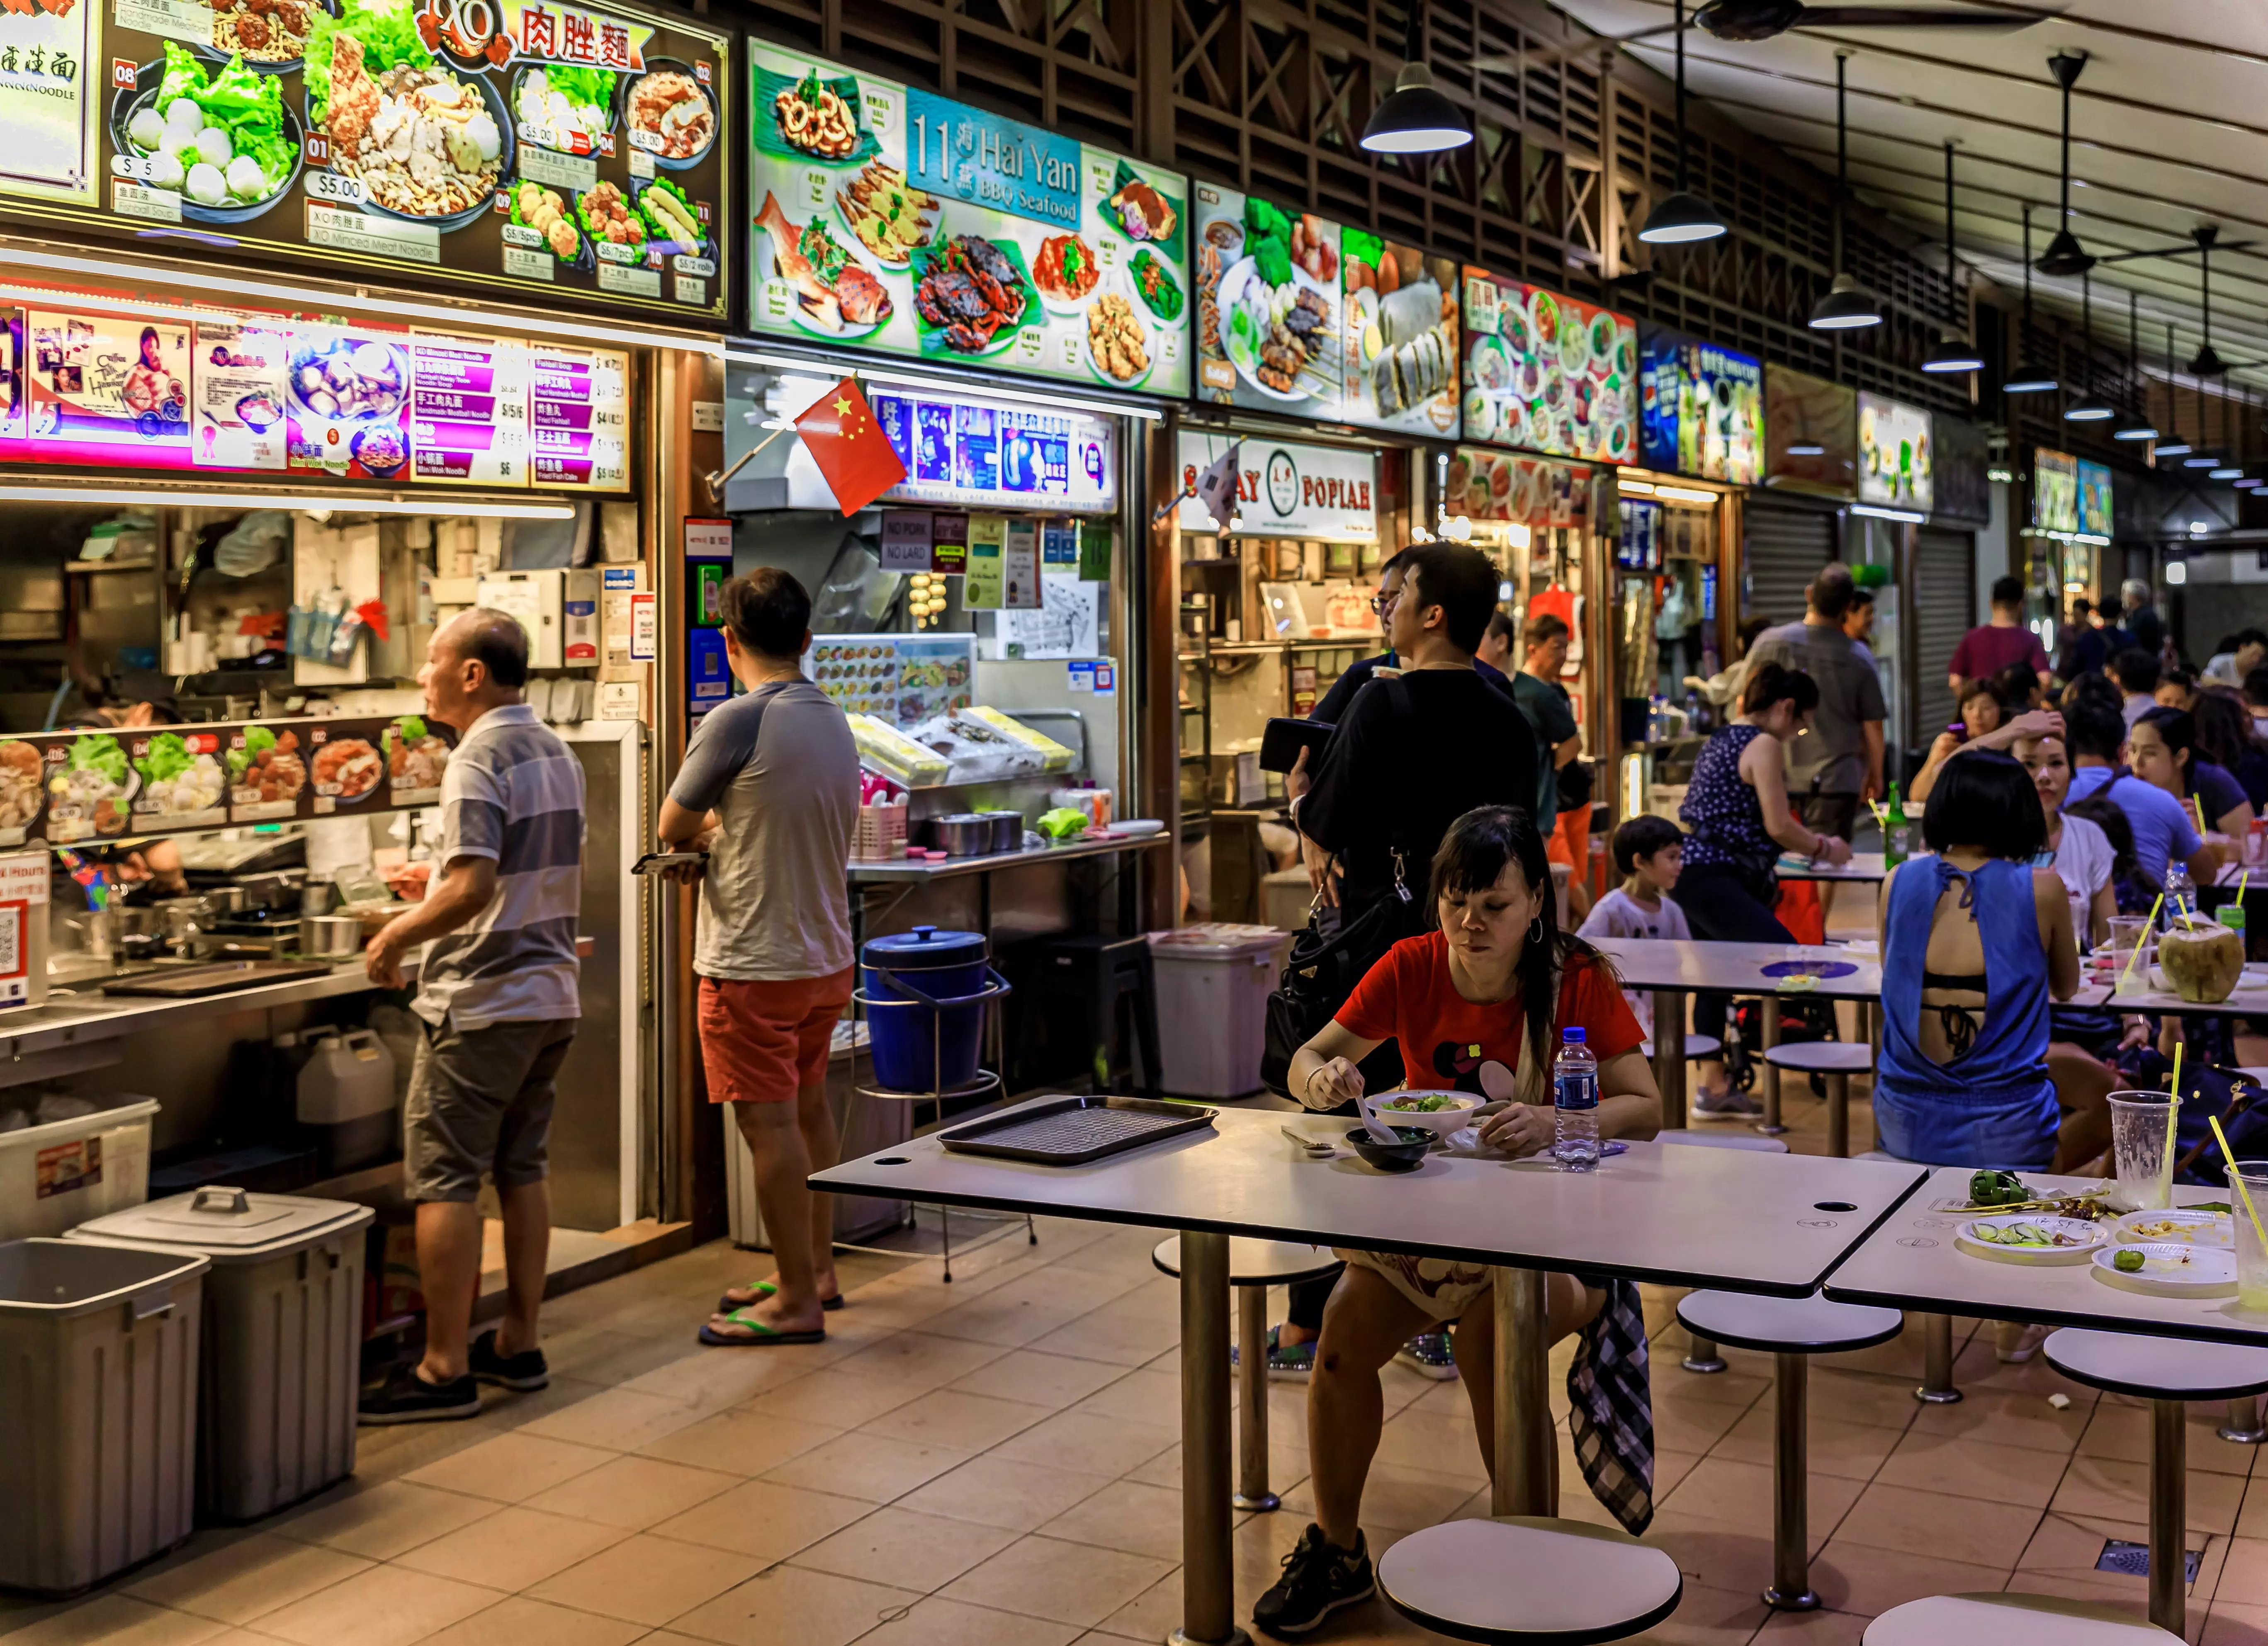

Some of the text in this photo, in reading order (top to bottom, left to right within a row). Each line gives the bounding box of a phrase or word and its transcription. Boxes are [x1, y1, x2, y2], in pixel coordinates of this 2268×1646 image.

[120, 6, 169, 25] Handmade
[120, 15, 151, 30] Noodle
[116, 65, 135, 84] 08
[697, 66, 710, 80] 02
[308, 138, 327, 158] 01
[600, 137, 614, 152] 04
[914, 114, 949, 182] 11
[980, 127, 1023, 178] Hai
[1030, 144, 1076, 195] Yan
[145, 163, 152, 175] 5
[319, 175, 360, 198] $5.00
[496, 193, 511, 208] 09
[980, 178, 1076, 222] BBQ Seafood
[153, 206, 175, 219] Soup
[698, 206, 709, 221] 11
[314, 230, 434, 259] XO Minced Meat Noodle
[650, 251, 662, 265] 10
[418, 407, 491, 419] Handmade Meatball Noodle
[291, 458, 306, 467] Mini
[325, 460, 350, 470] Noodle
[1302, 475, 1371, 511] POPIAH
[887, 522, 926, 535] NO PORK
[887, 547, 925, 560] NO LARD
